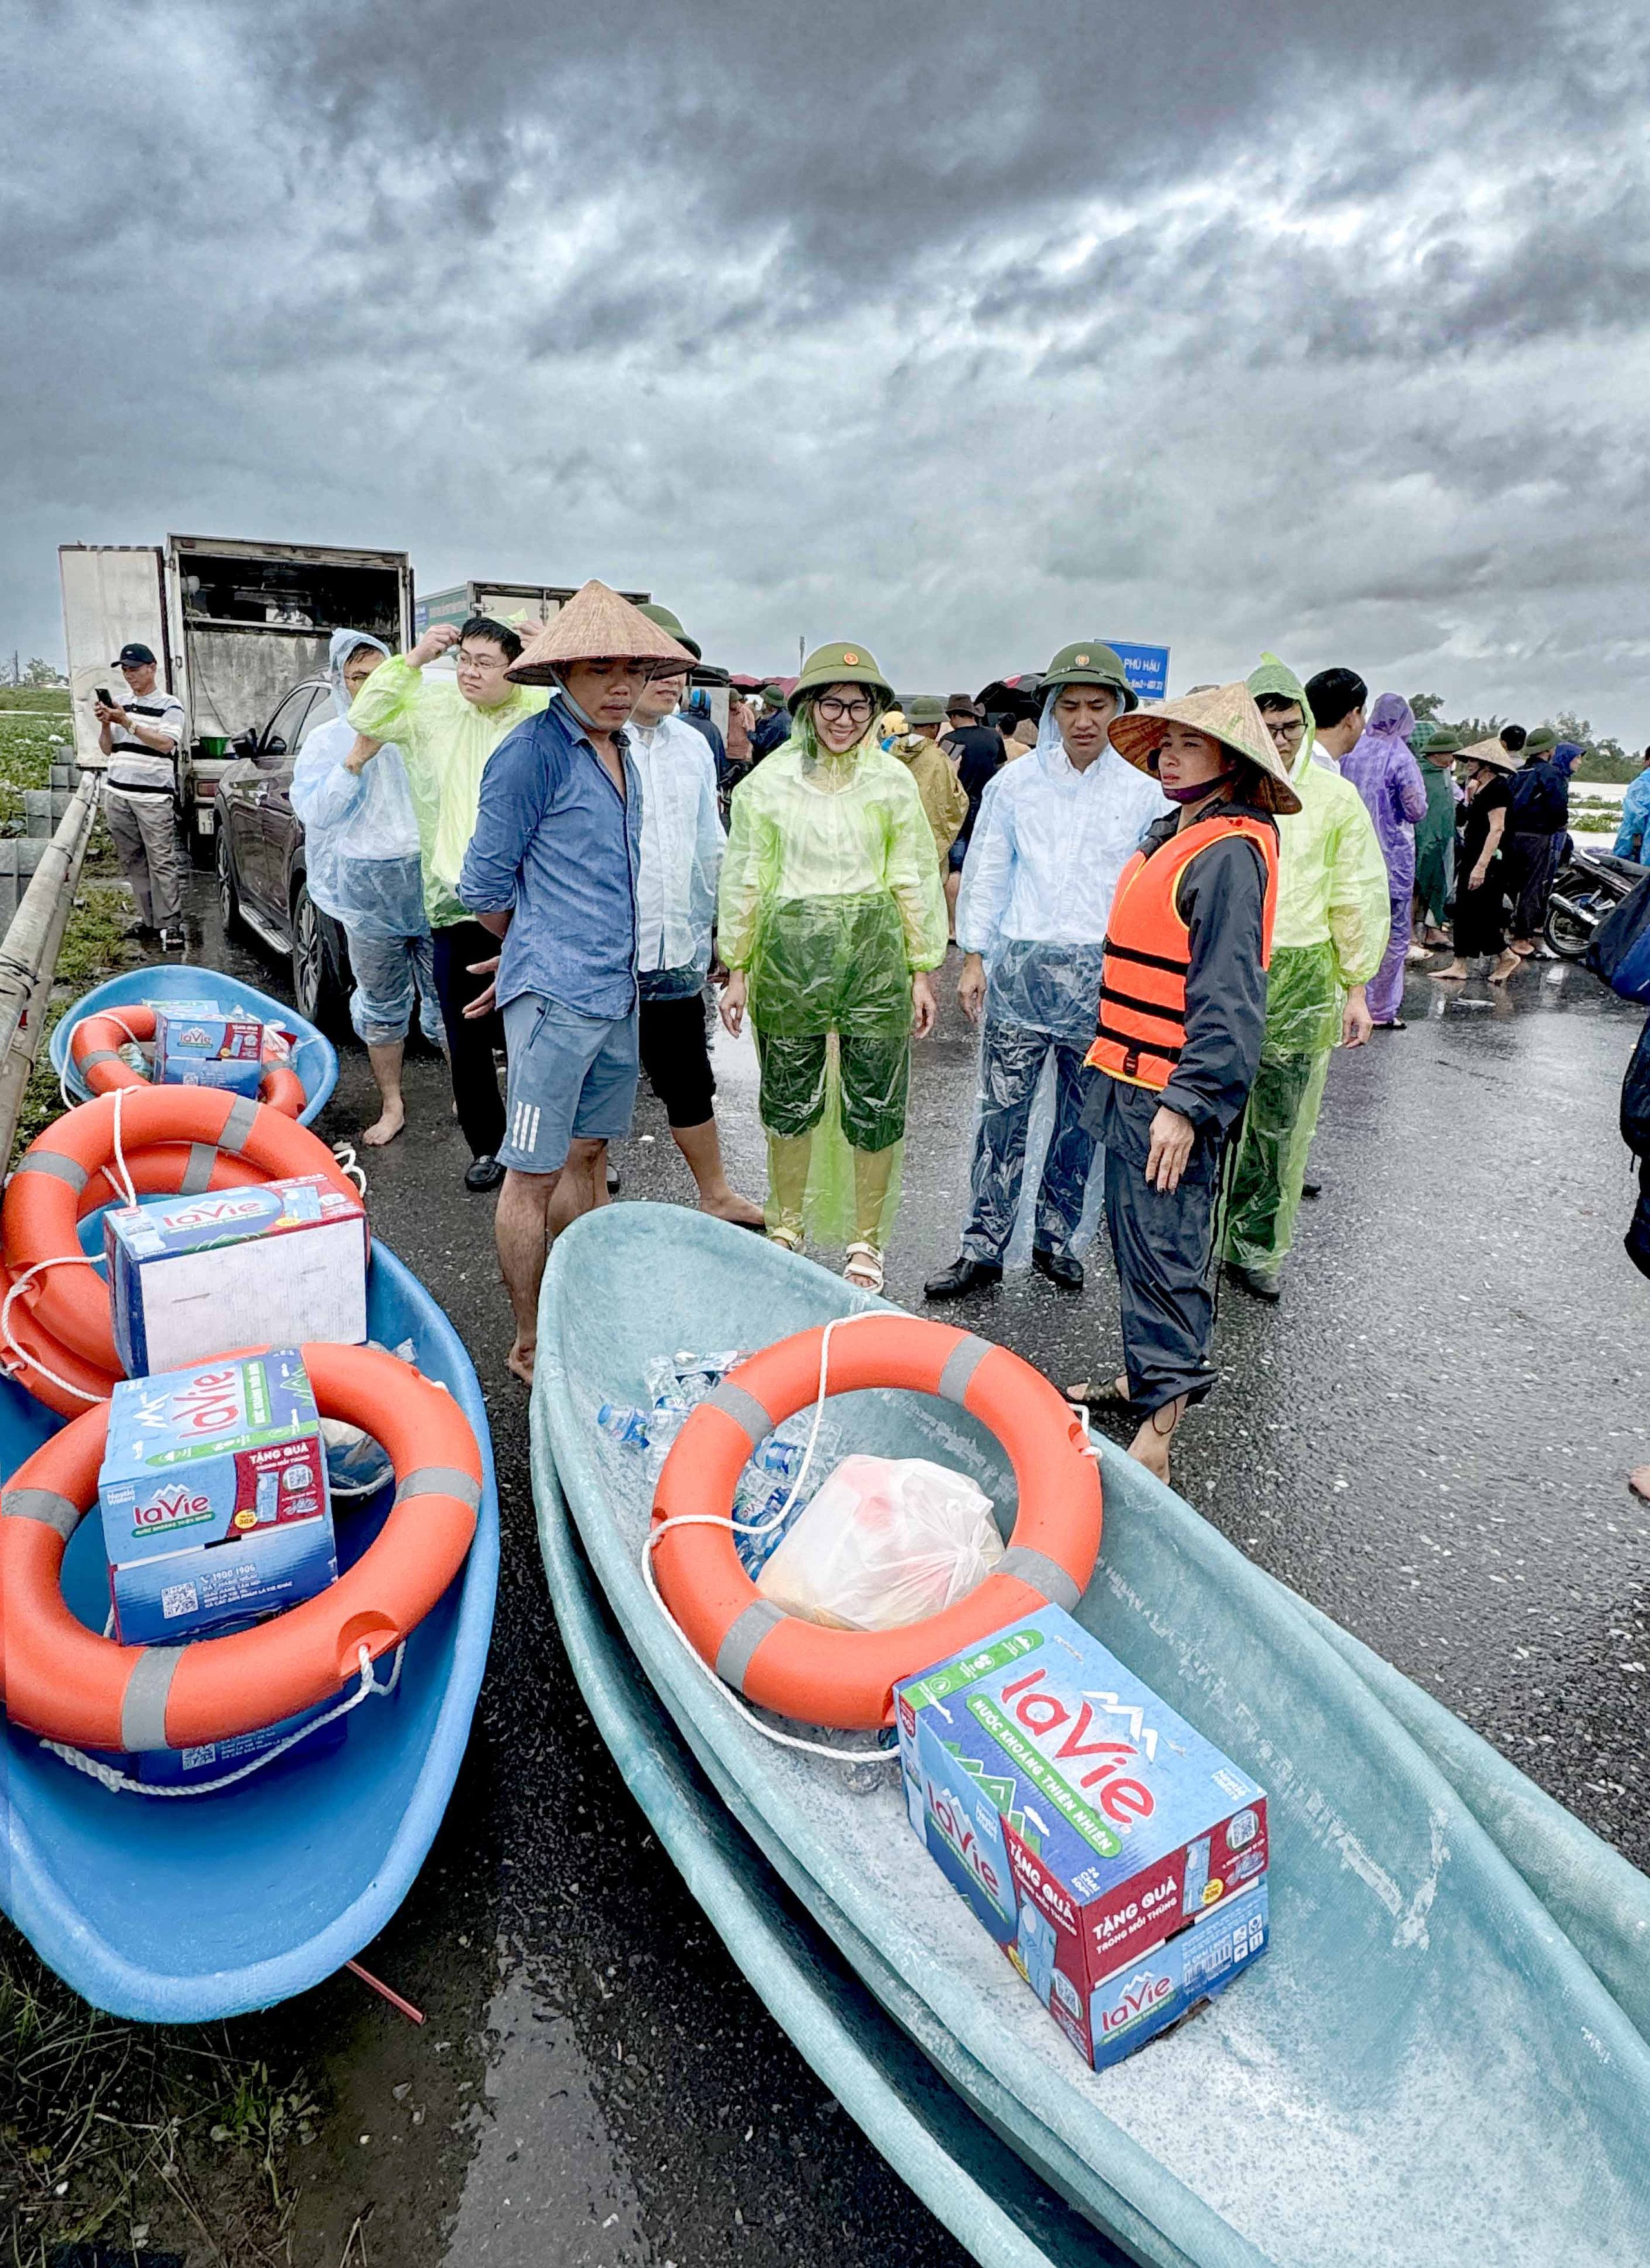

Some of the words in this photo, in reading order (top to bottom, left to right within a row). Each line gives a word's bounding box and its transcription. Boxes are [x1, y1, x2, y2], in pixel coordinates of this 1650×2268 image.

[1142, 659, 1161, 674] HẬU
[180, 1031, 212, 1045] laVie
[162, 1201, 261, 1229] laVie
[171, 1370, 239, 1439] laVie
[249, 1449, 282, 1465] TẶNG
[283, 1442, 309, 1457] QUÀ
[134, 1493, 209, 1526] laVie
[213, 1569, 233, 1581] 1900
[1001, 1667, 1155, 1826] laVie
[972, 1699, 1003, 1731] NƯỚC
[999, 1728, 1045, 1777] KHOÁNG
[1041, 1774, 1076, 1812] THIÊN
[1072, 1811, 1113, 1852] NHIÊN
[927, 1781, 1000, 1897] laVie
[1080, 1871, 1102, 1893] CHAI
[1042, 1883, 1075, 1923] QUÀ
[1092, 1902, 1138, 1941] TẶNG
[1141, 1875, 1178, 1909] QUÀ
[1096, 1930, 1128, 1955] TRONG
[1147, 1897, 1178, 1920] THÙNG
[1102, 1976, 1172, 2031] laVie
